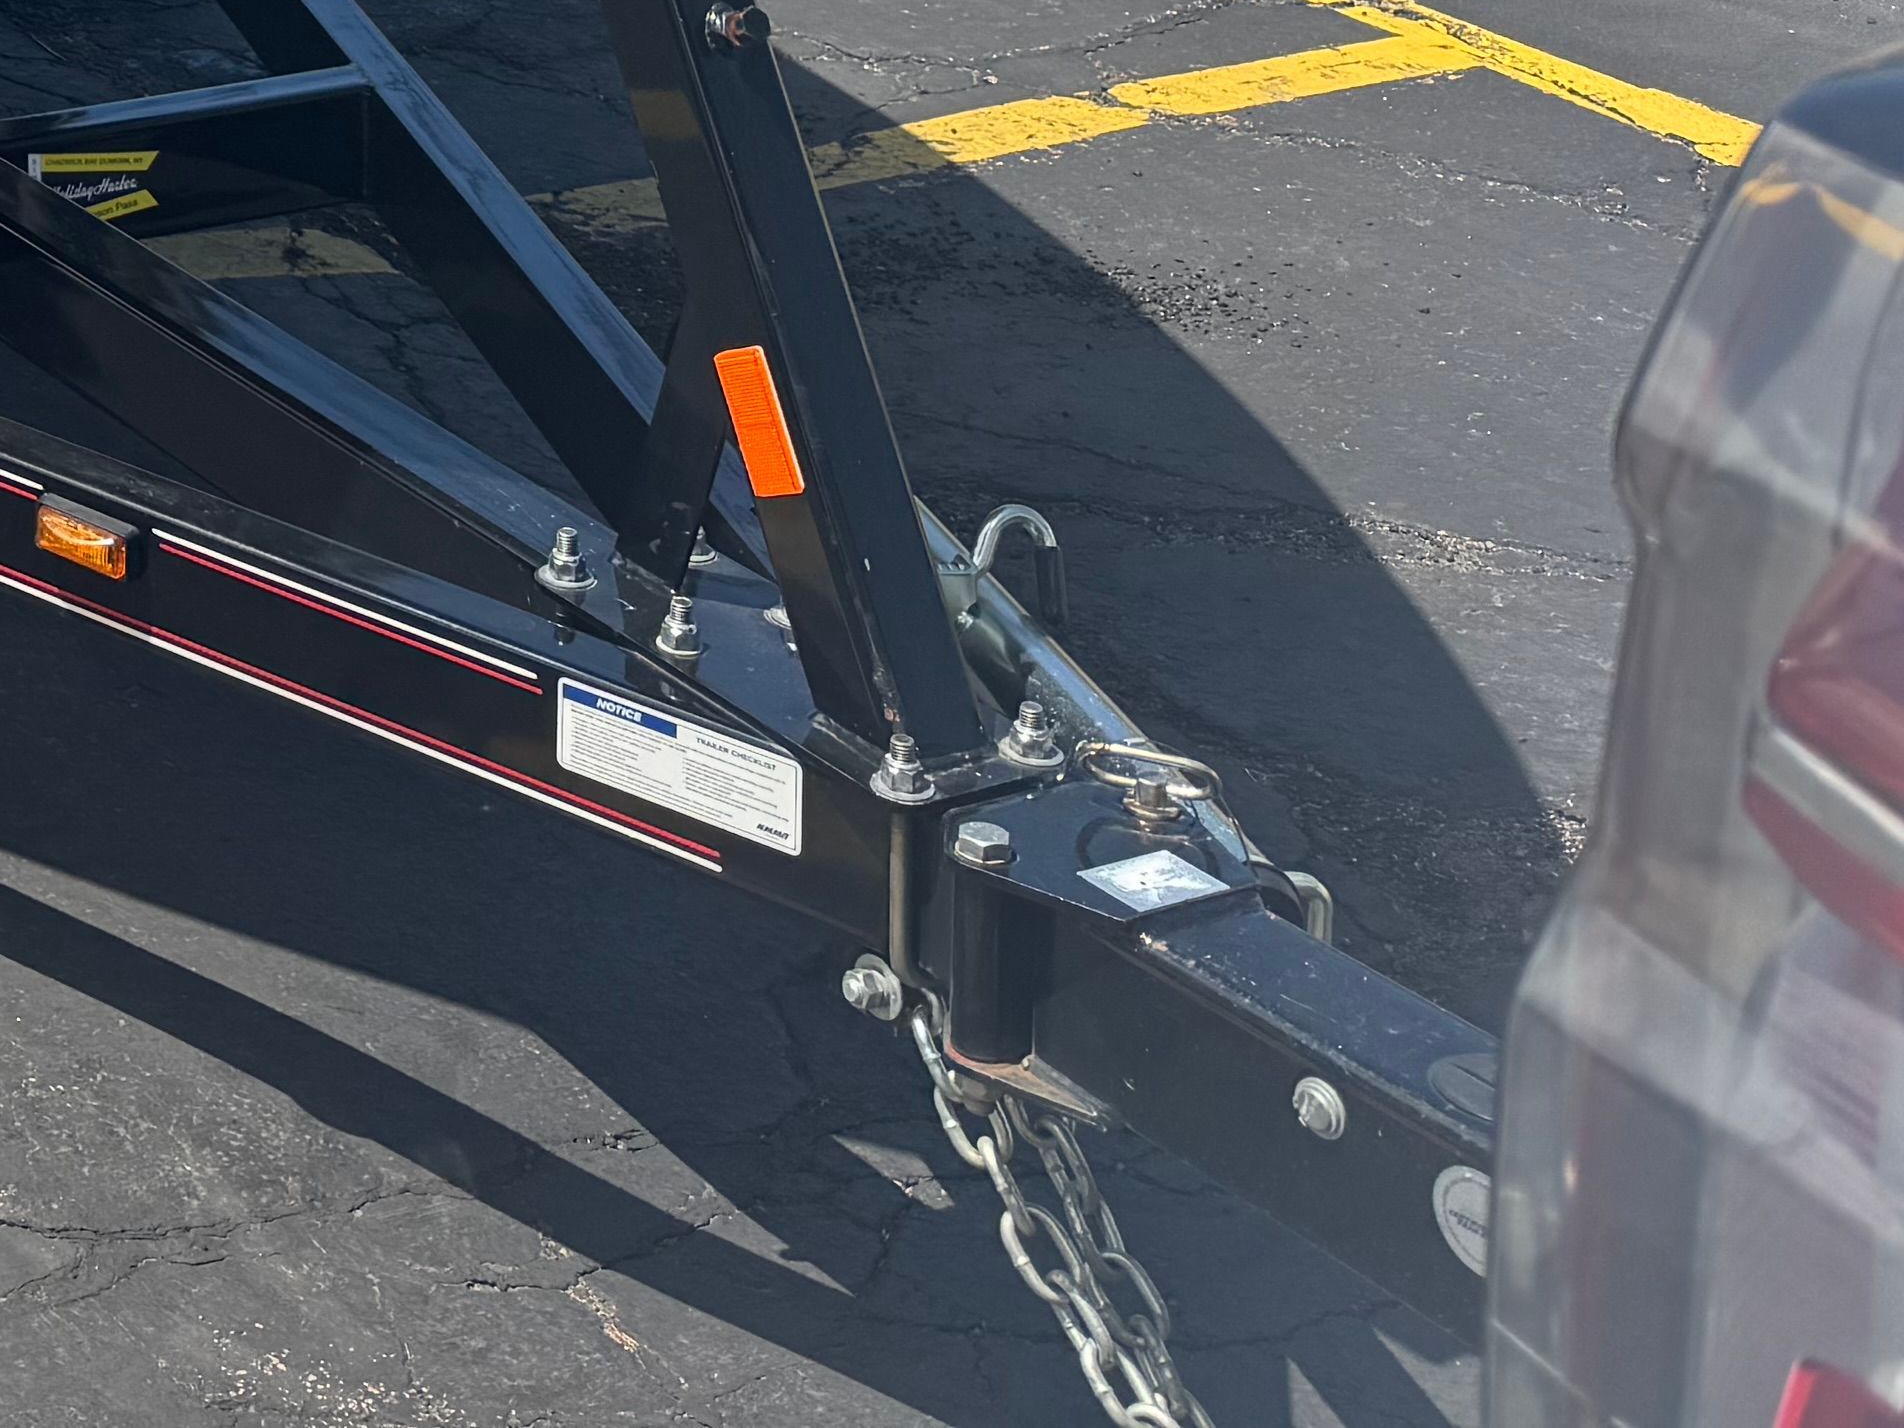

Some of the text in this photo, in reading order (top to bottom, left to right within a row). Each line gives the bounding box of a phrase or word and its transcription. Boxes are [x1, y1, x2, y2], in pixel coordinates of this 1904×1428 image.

[596, 697, 642, 723] NOTICE
[695, 736, 777, 771] TRAILER CHECKLIST
